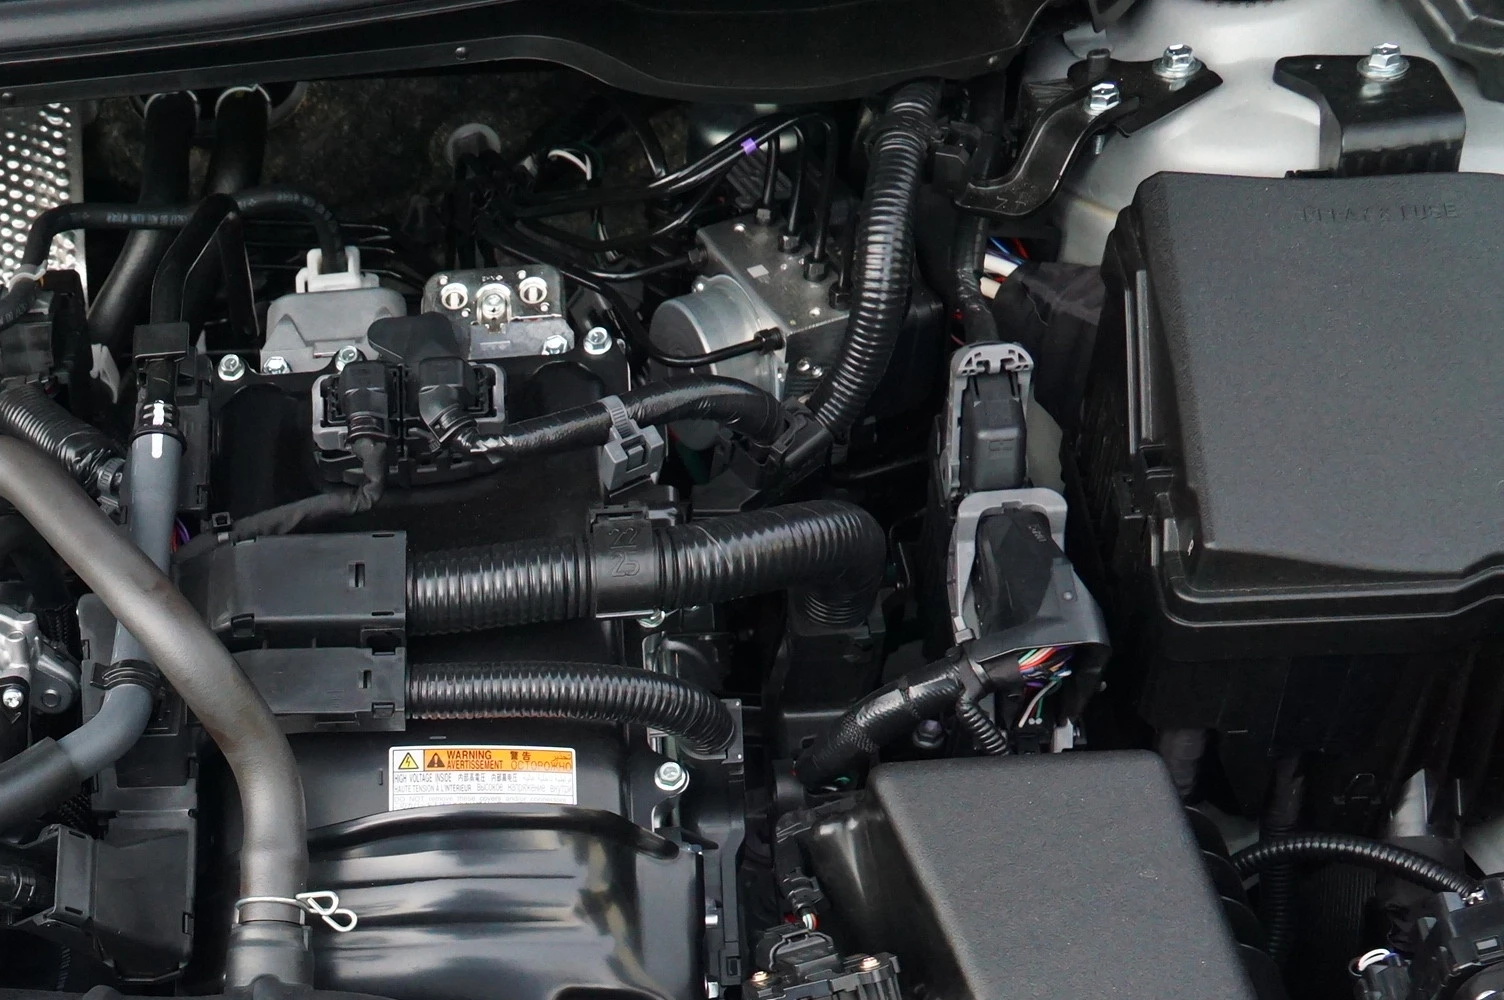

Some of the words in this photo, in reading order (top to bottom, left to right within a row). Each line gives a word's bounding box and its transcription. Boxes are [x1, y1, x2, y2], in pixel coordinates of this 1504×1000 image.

[447, 750, 492, 760] WARNING
[447, 760, 504, 770] AVERTISSEMENT
[394, 773, 407, 783] HIGH
[409, 773, 433, 783] VOLTAGE
[436, 772, 452, 783] INSIDE
